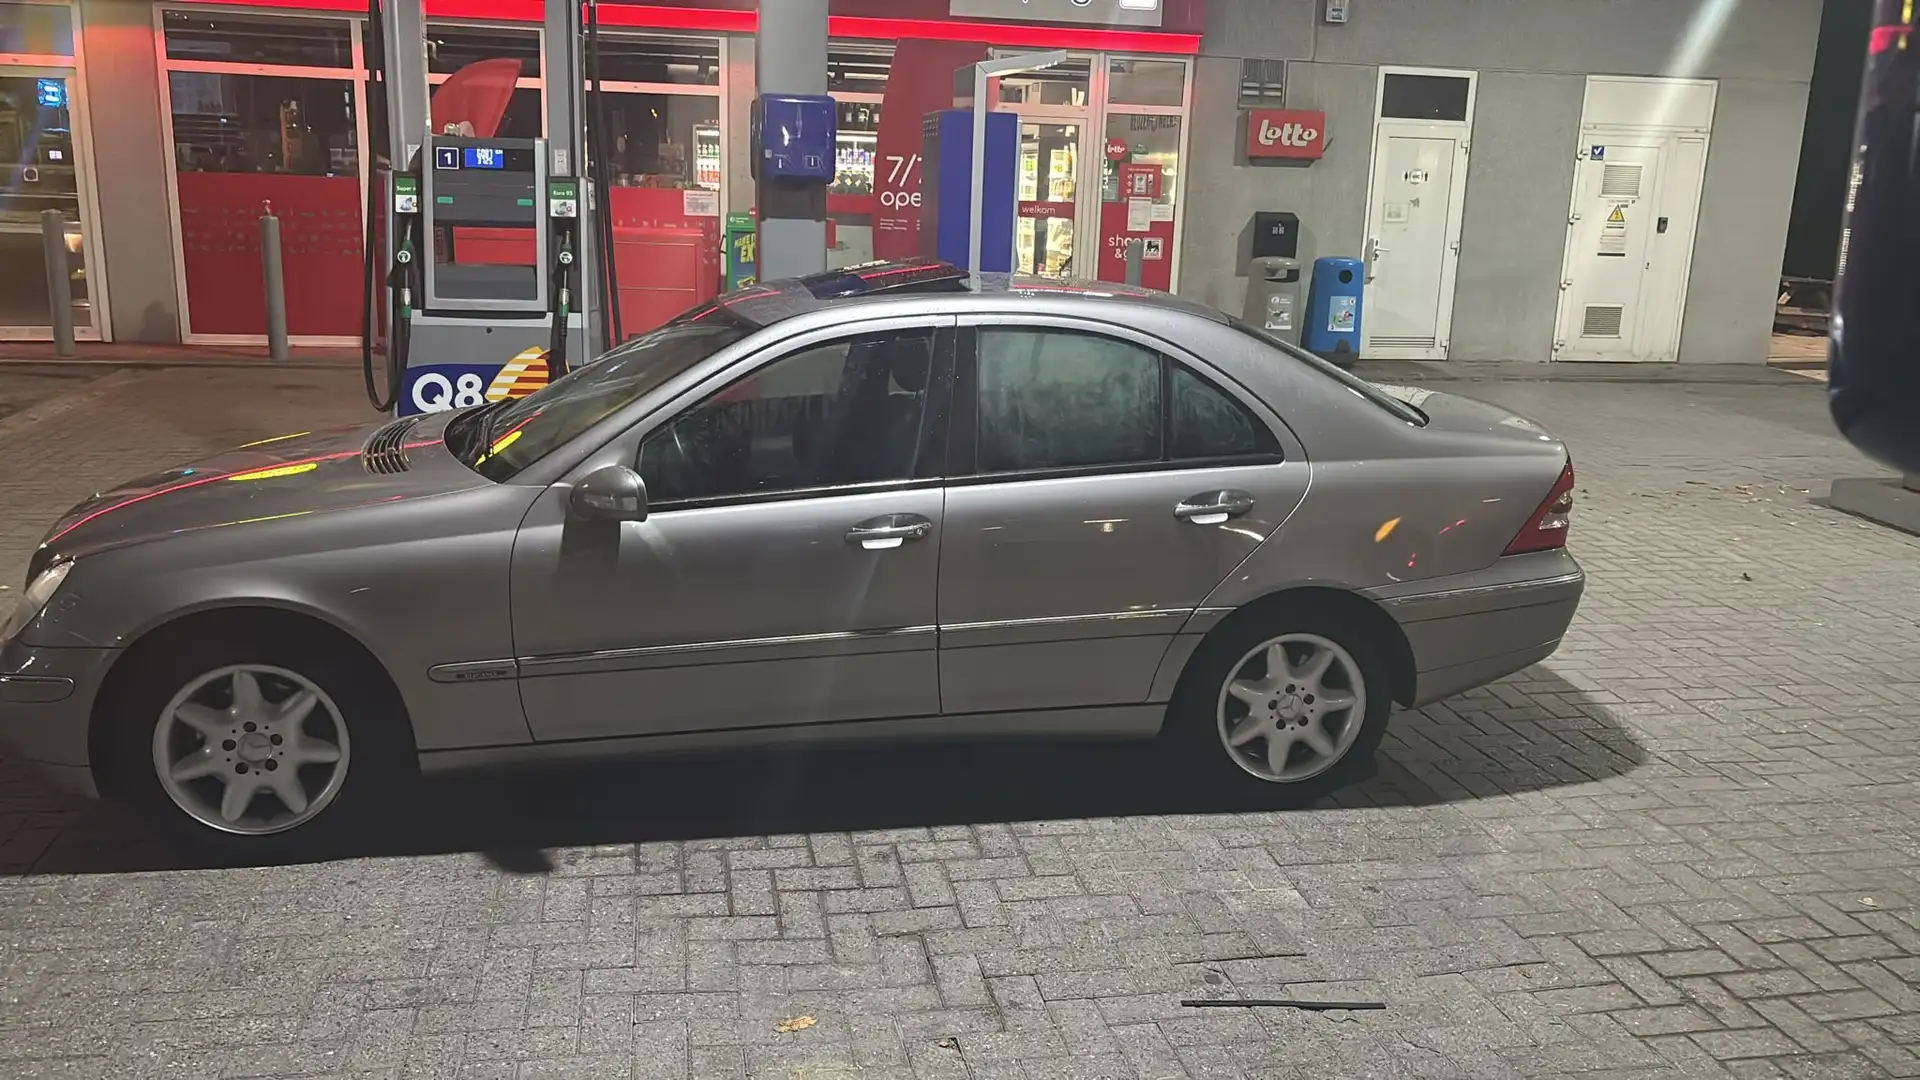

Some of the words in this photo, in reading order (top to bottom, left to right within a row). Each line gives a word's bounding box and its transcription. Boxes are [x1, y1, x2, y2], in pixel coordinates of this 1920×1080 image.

[1258, 119, 1318, 147] lotto
[444, 152, 452, 165] 1
[886, 153, 922, 187] 7/
[1022, 205, 1056, 214] welkom
[411, 372, 484, 413] Q8
